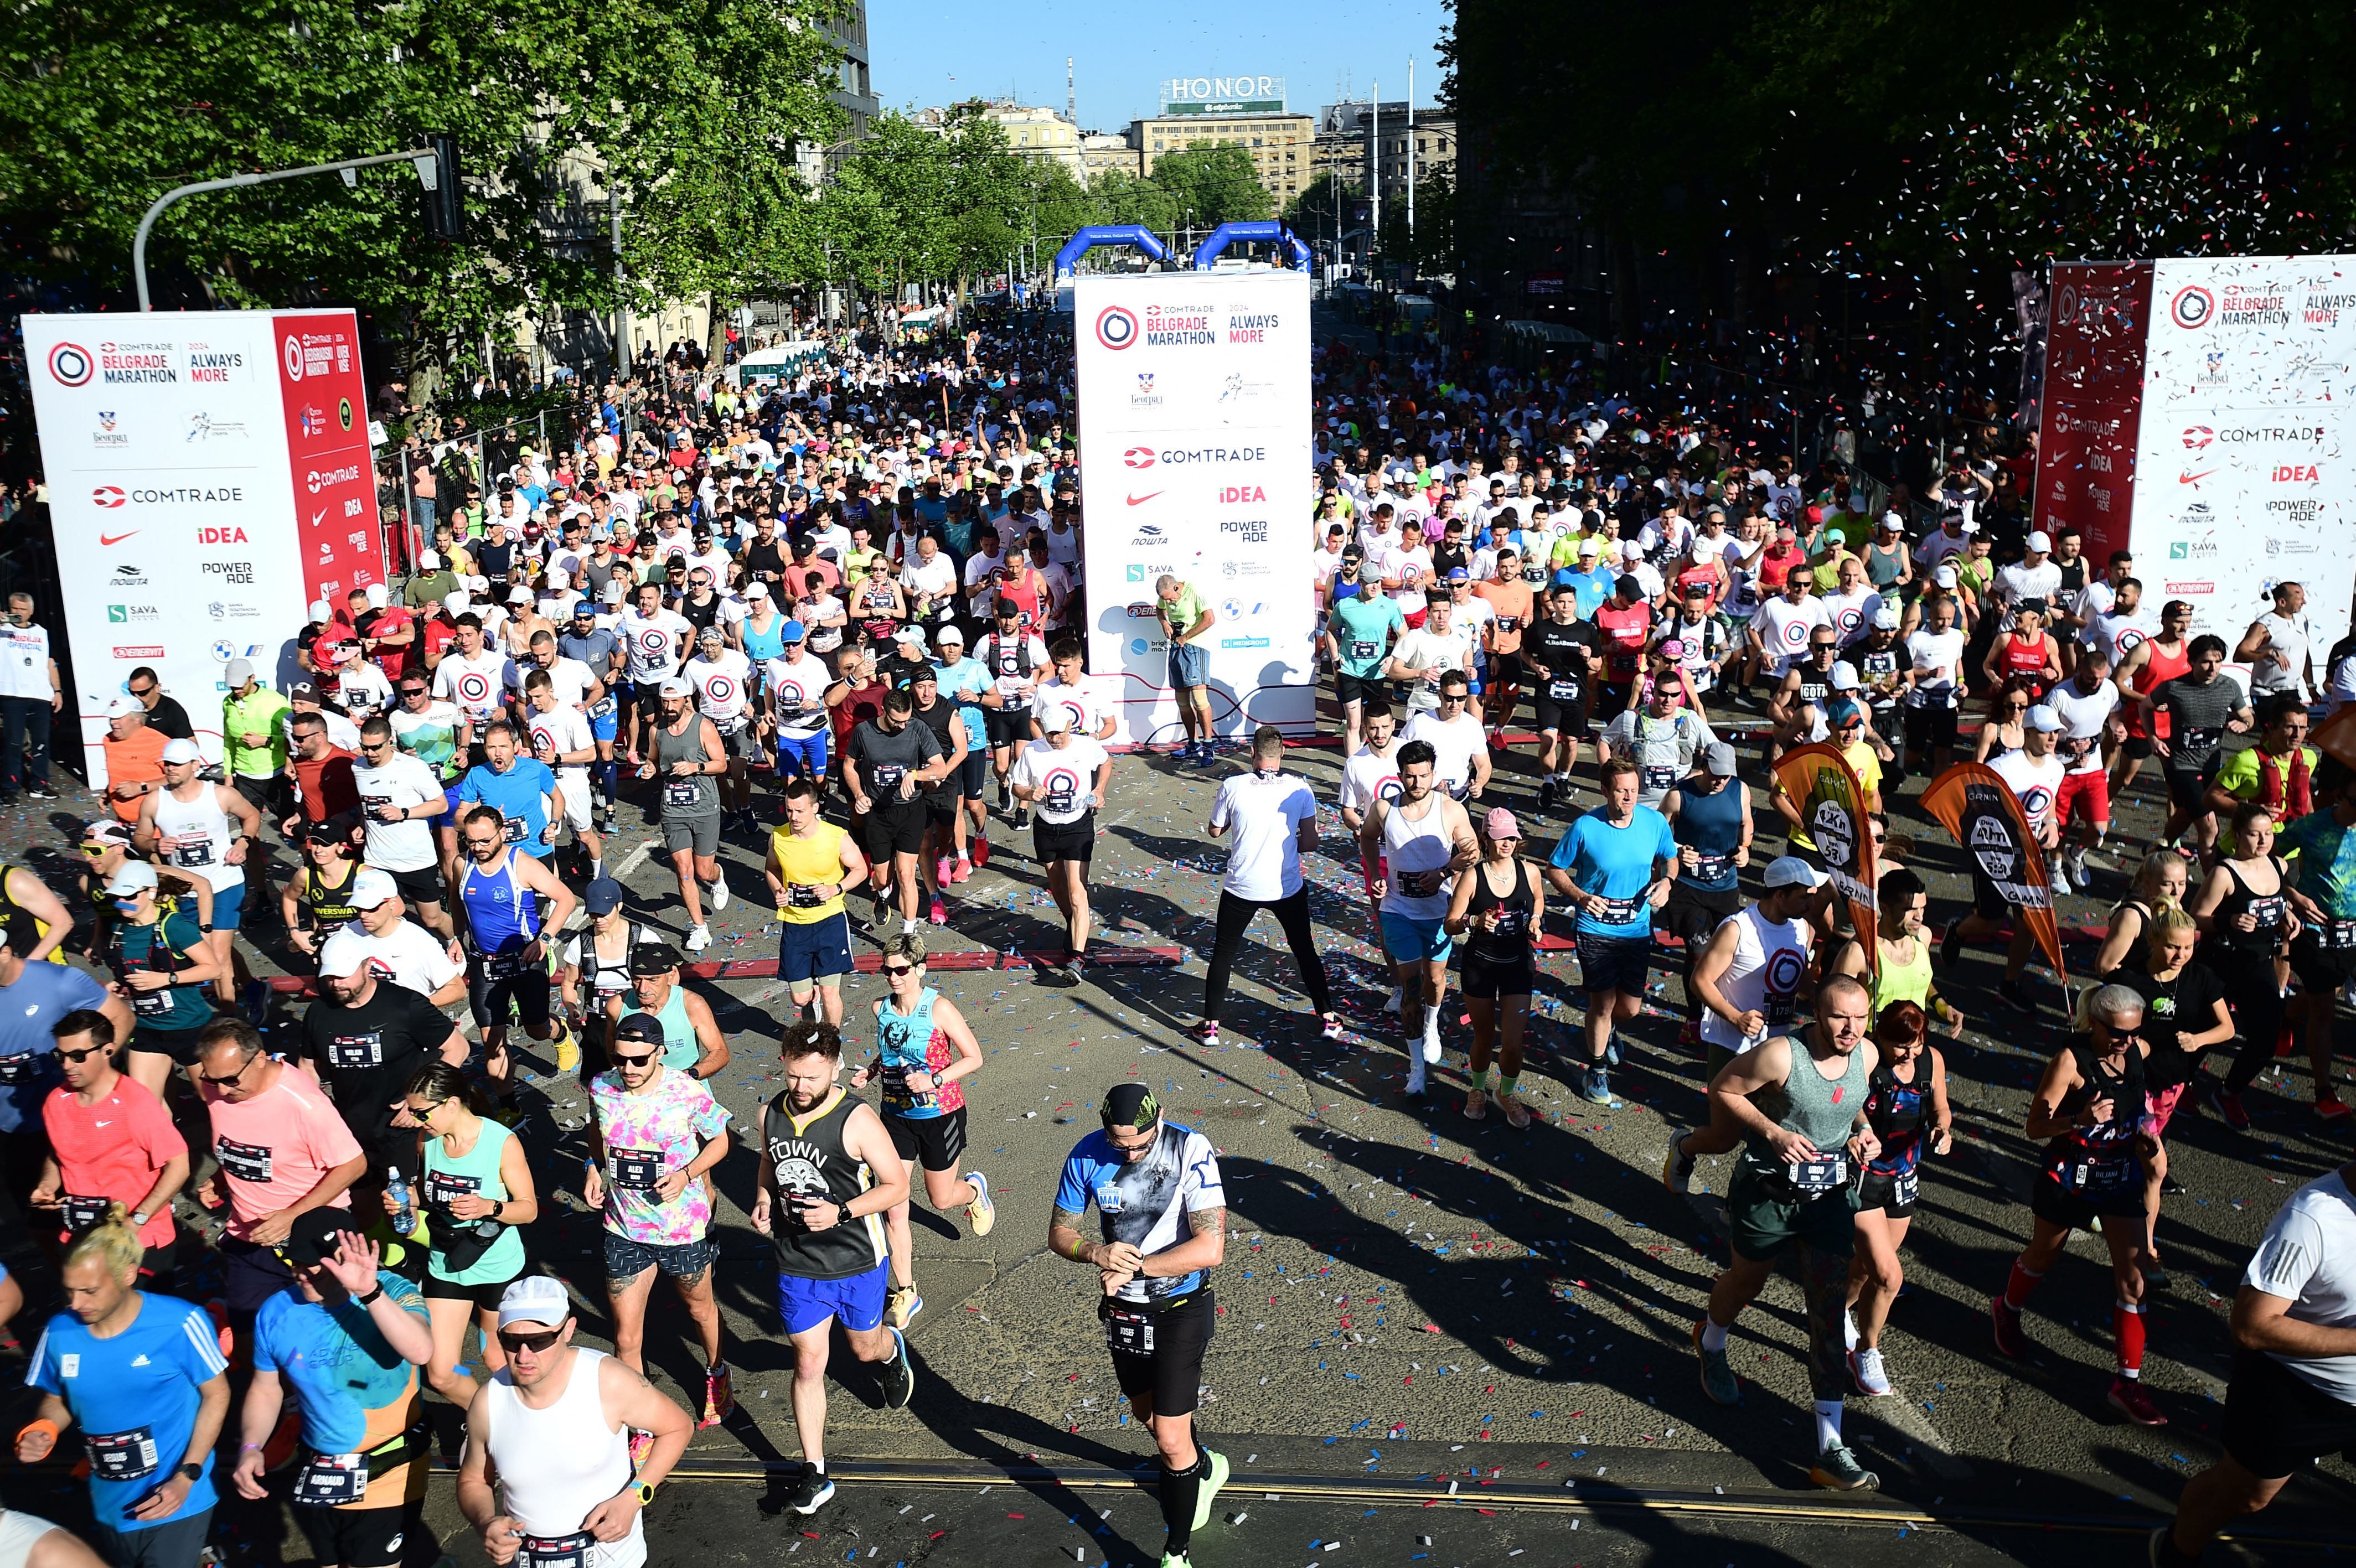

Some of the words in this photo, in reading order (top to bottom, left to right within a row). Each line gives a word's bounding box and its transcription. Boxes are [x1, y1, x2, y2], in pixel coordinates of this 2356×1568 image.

[1172, 76, 1273, 99] HONOR
[2223, 297, 2285, 311] BELGRADE
[2306, 294, 2356, 308] ALWAYS
[1164, 305, 1215, 314] COMTRADE
[2303, 309, 2339, 323] MORE
[1147, 317, 1208, 332] BELGRADE
[1229, 314, 1278, 329] ALWAYS
[2221, 311, 2290, 325] MARATHON
[1148, 331, 1215, 346] MARATHON
[1229, 330, 1264, 343] MORE
[118, 343, 173, 351] COMTRADE
[101, 355, 168, 369] BELGRADE
[191, 354, 242, 368] ALWAYS
[104, 369, 177, 384] MARATHON
[191, 369, 230, 382] MORE
[1132, 394, 1162, 405] Београд
[2070, 417, 2116, 437] COMTRADE
[2220, 427, 2324, 442] COMTRADE
[1162, 447, 1265, 463] COMTRADE
[2090, 454, 2113, 473] iDEA
[321, 465, 359, 487] COMTRADE
[2271, 465, 2319, 482] iDEA
[132, 488, 243, 503] COMTRADE
[1220, 486, 1266, 503] iDEA
[344, 498, 364, 518] iDEA
[2269, 500, 2317, 511] POWER
[844, 513, 863, 521] USA
[2289, 511, 2316, 521] ADE
[1221, 521, 1268, 532] POWER
[197, 527, 249, 544] iDEA
[348, 530, 366, 545] POWER
[1131, 537, 1168, 546] ПОШТА
[1242, 532, 1268, 542] ADE
[356, 541, 368, 553] ADE
[2192, 543, 2218, 551] SAVA
[202, 562, 253, 573] POWER
[1148, 565, 1174, 573] SAVA
[109, 578, 149, 586] ПОШТА
[226, 573, 255, 584] ADE
[130, 606, 158, 614] SAVA
[2263, 908, 2277, 917] ELENA
[768, 1139, 828, 1169] TOWN
[627, 1165, 644, 1174] ALEX
[1100, 1196, 1119, 1205] MAN
[1119, 1327, 1134, 1337] JOSEF
[308, 1354, 354, 1369] GROUP
[309, 1474, 345, 1487] ARNAUD
[535, 1557, 576, 1568] VLADIMIR
